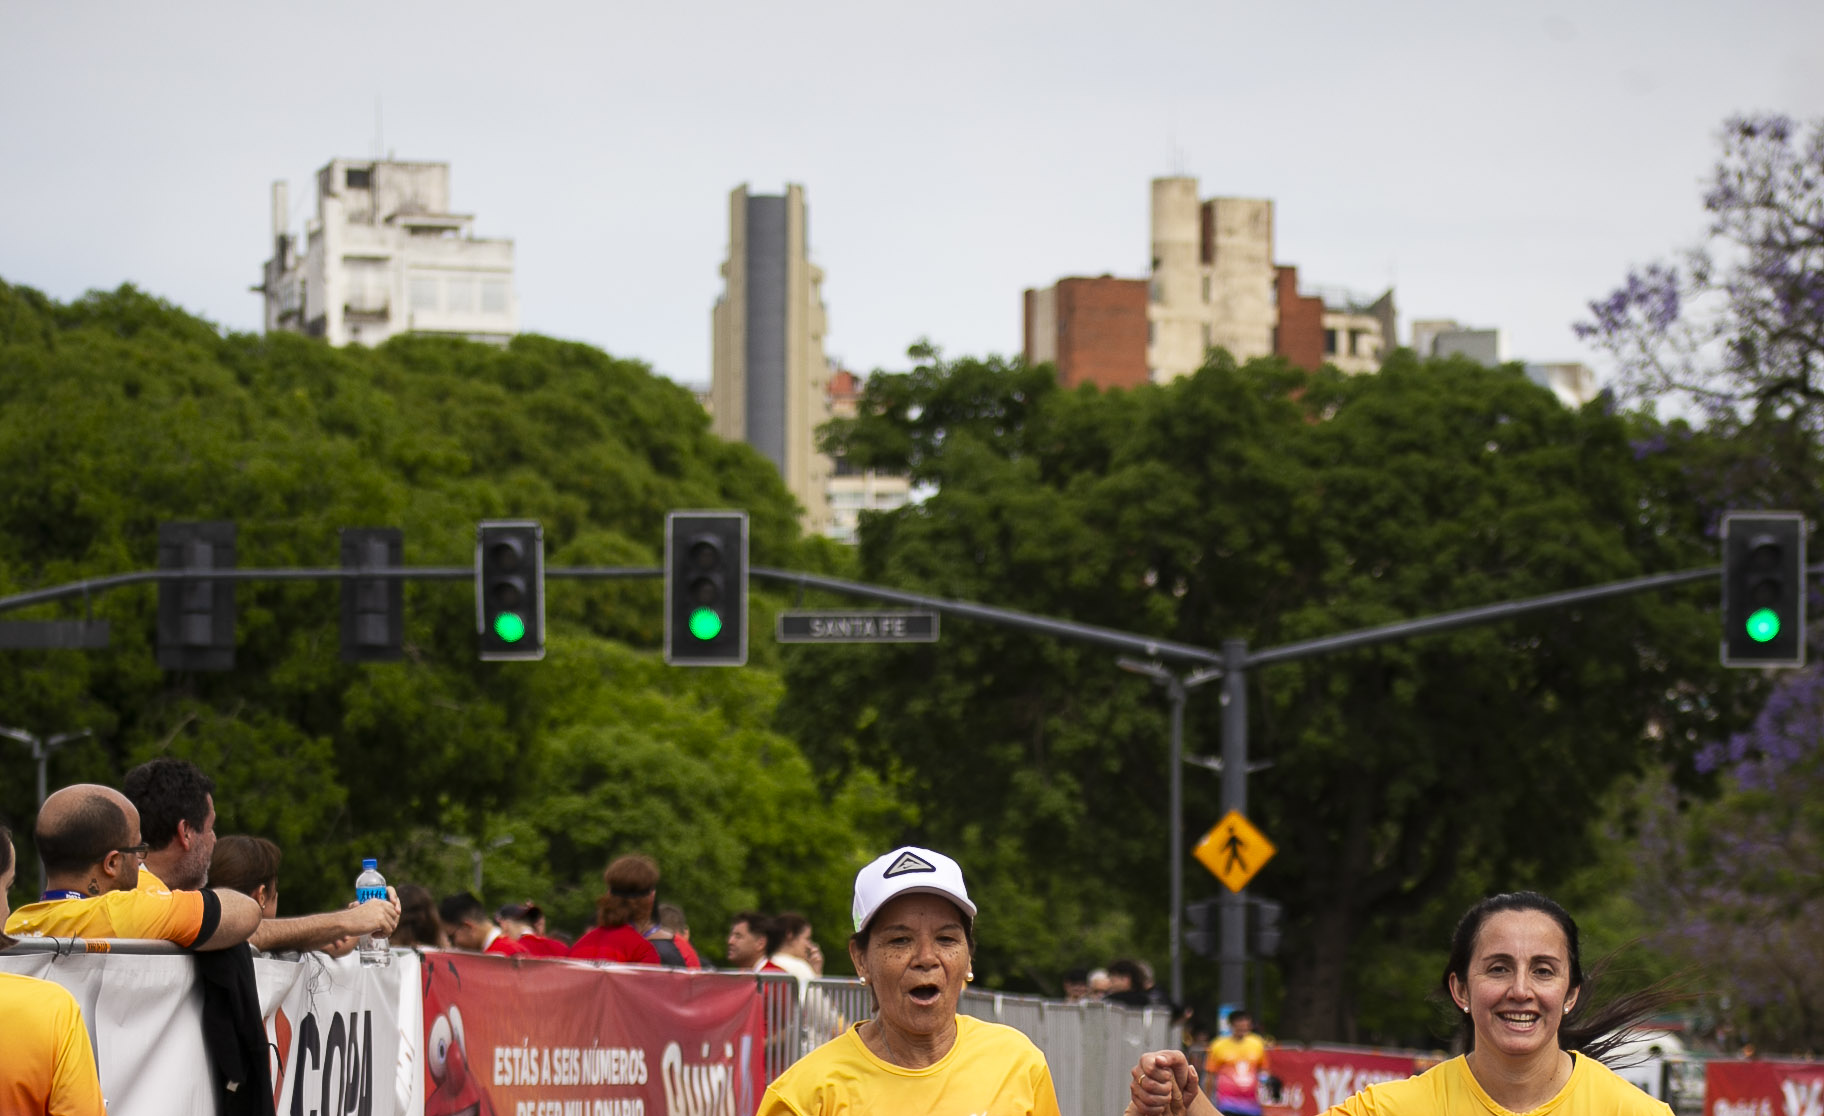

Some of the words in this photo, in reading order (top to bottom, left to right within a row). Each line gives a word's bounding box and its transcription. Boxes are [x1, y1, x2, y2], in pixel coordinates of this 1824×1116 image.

[808, 617, 878, 638] SANTA
[879, 617, 908, 638] FE
[493, 1037, 539, 1086] ESTÁS
[541, 1048, 552, 1086] A
[553, 1047, 580, 1086] SEIS
[582, 1038, 648, 1086] NÚMEROS
